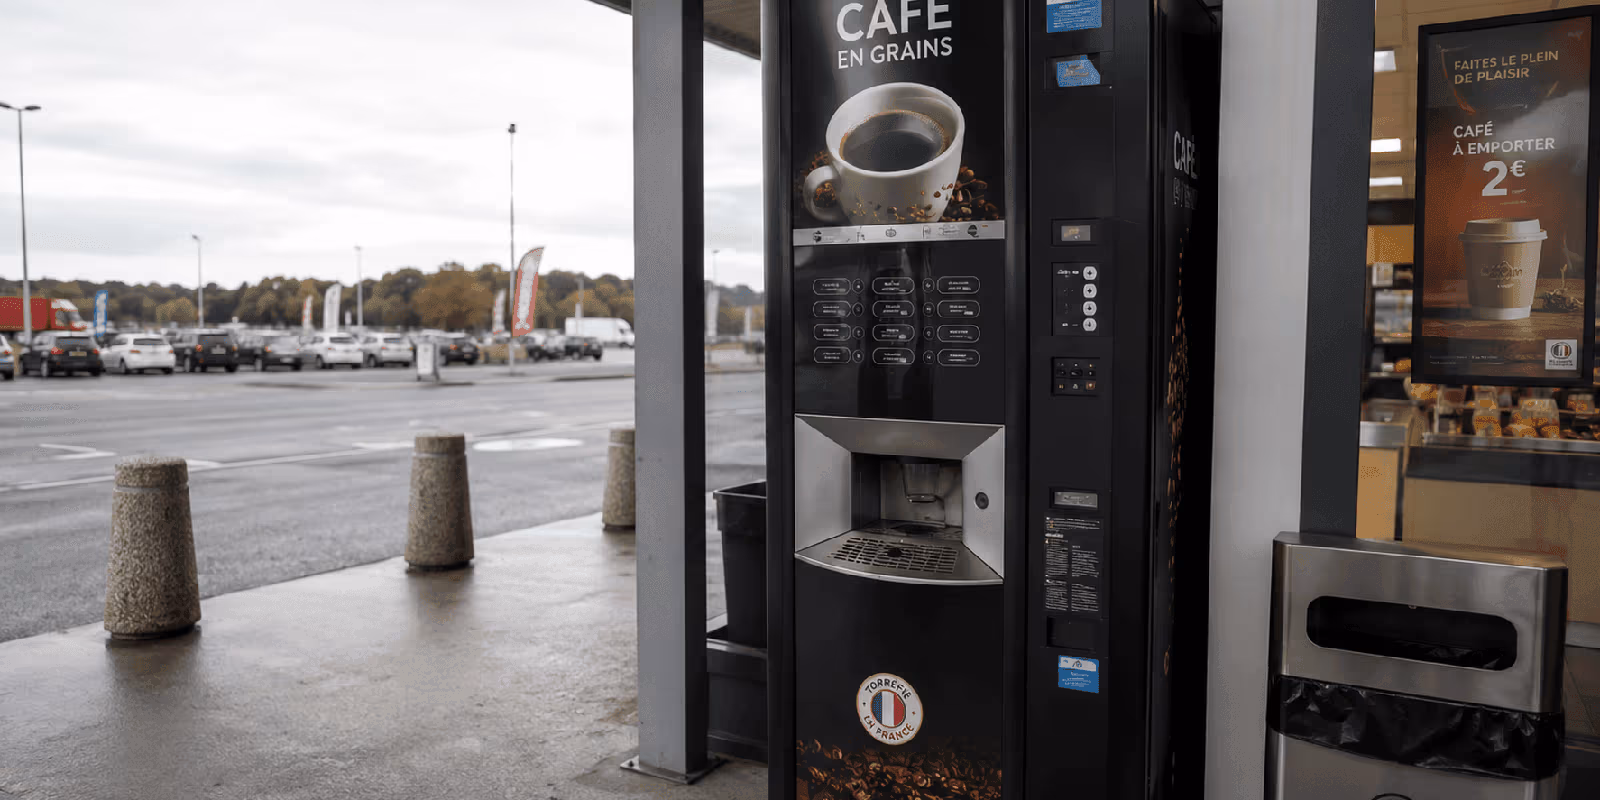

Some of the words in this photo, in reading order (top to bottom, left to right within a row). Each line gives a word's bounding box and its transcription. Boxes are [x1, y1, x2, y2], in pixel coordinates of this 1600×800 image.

[838, 48, 863, 69] EN
[870, 36, 953, 63] GRAINS
[1454, 57, 1497, 70] FAITES
[1501, 55, 1517, 66] LE
[1521, 50, 1559, 64] PLEIN
[1454, 72, 1473, 85] DE
[1477, 67, 1530, 82] PLAISIR
[1453, 120, 1493, 138] CAFÉ
[1452, 141, 1464, 155] À
[1467, 137, 1555, 155] EMPORTER
